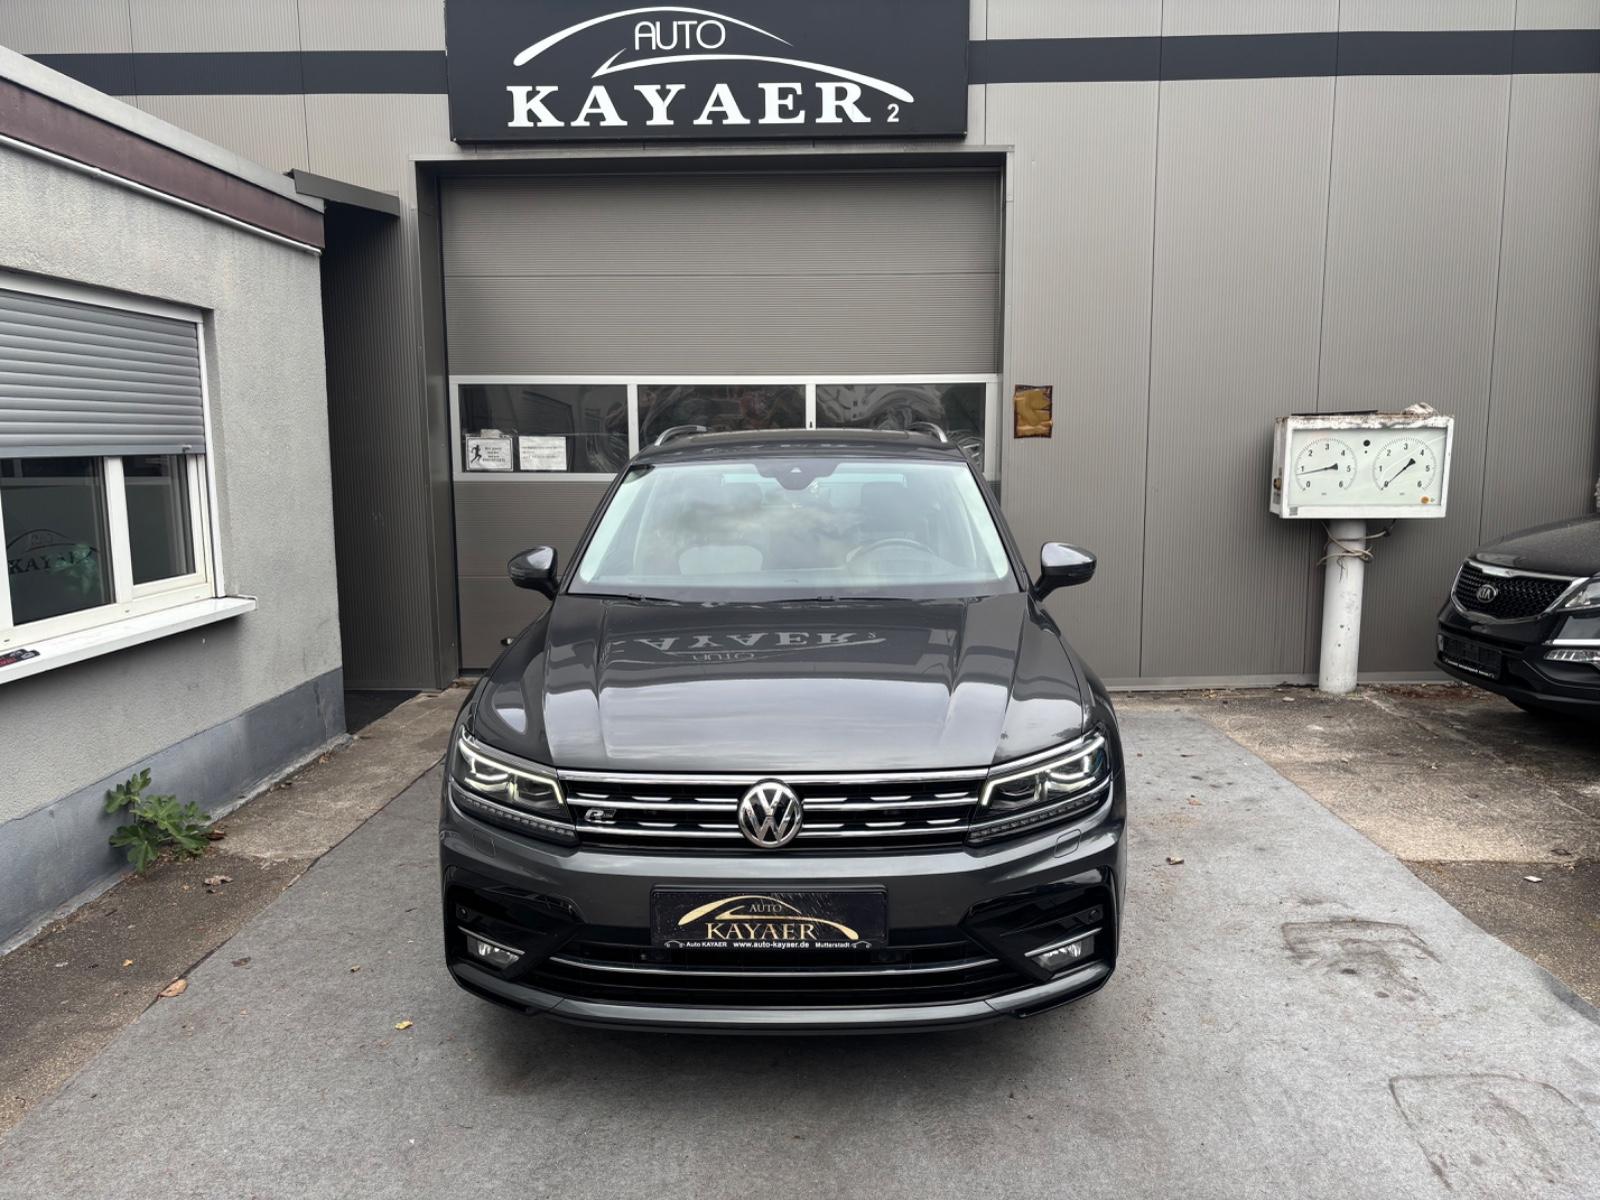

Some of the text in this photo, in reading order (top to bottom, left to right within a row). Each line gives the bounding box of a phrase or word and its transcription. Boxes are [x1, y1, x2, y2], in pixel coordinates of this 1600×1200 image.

[635, 19, 726, 50] AUTO
[507, 82, 900, 128] KAYAER 2
[749, 904, 783, 913] AUTO
[705, 922, 818, 940] KAYAER
[733, 941, 810, 950] www.auto-kayaer.de
